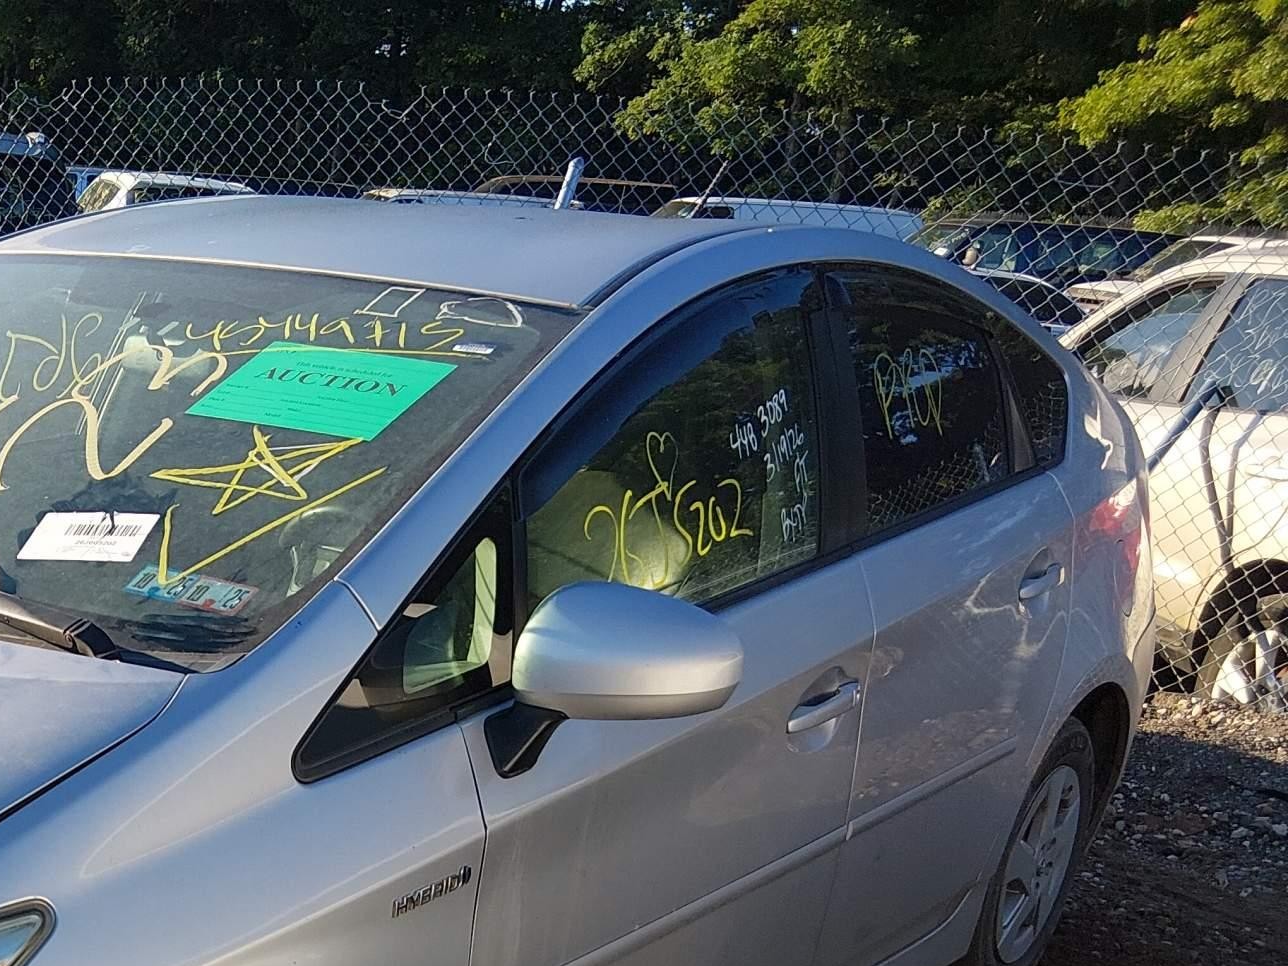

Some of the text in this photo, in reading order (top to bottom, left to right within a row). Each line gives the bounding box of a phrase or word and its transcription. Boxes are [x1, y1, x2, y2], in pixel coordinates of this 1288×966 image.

[254, 367, 408, 397] AUCTION
[757, 389, 788, 438] 3089
[392, 873, 460, 918] HYBRID
